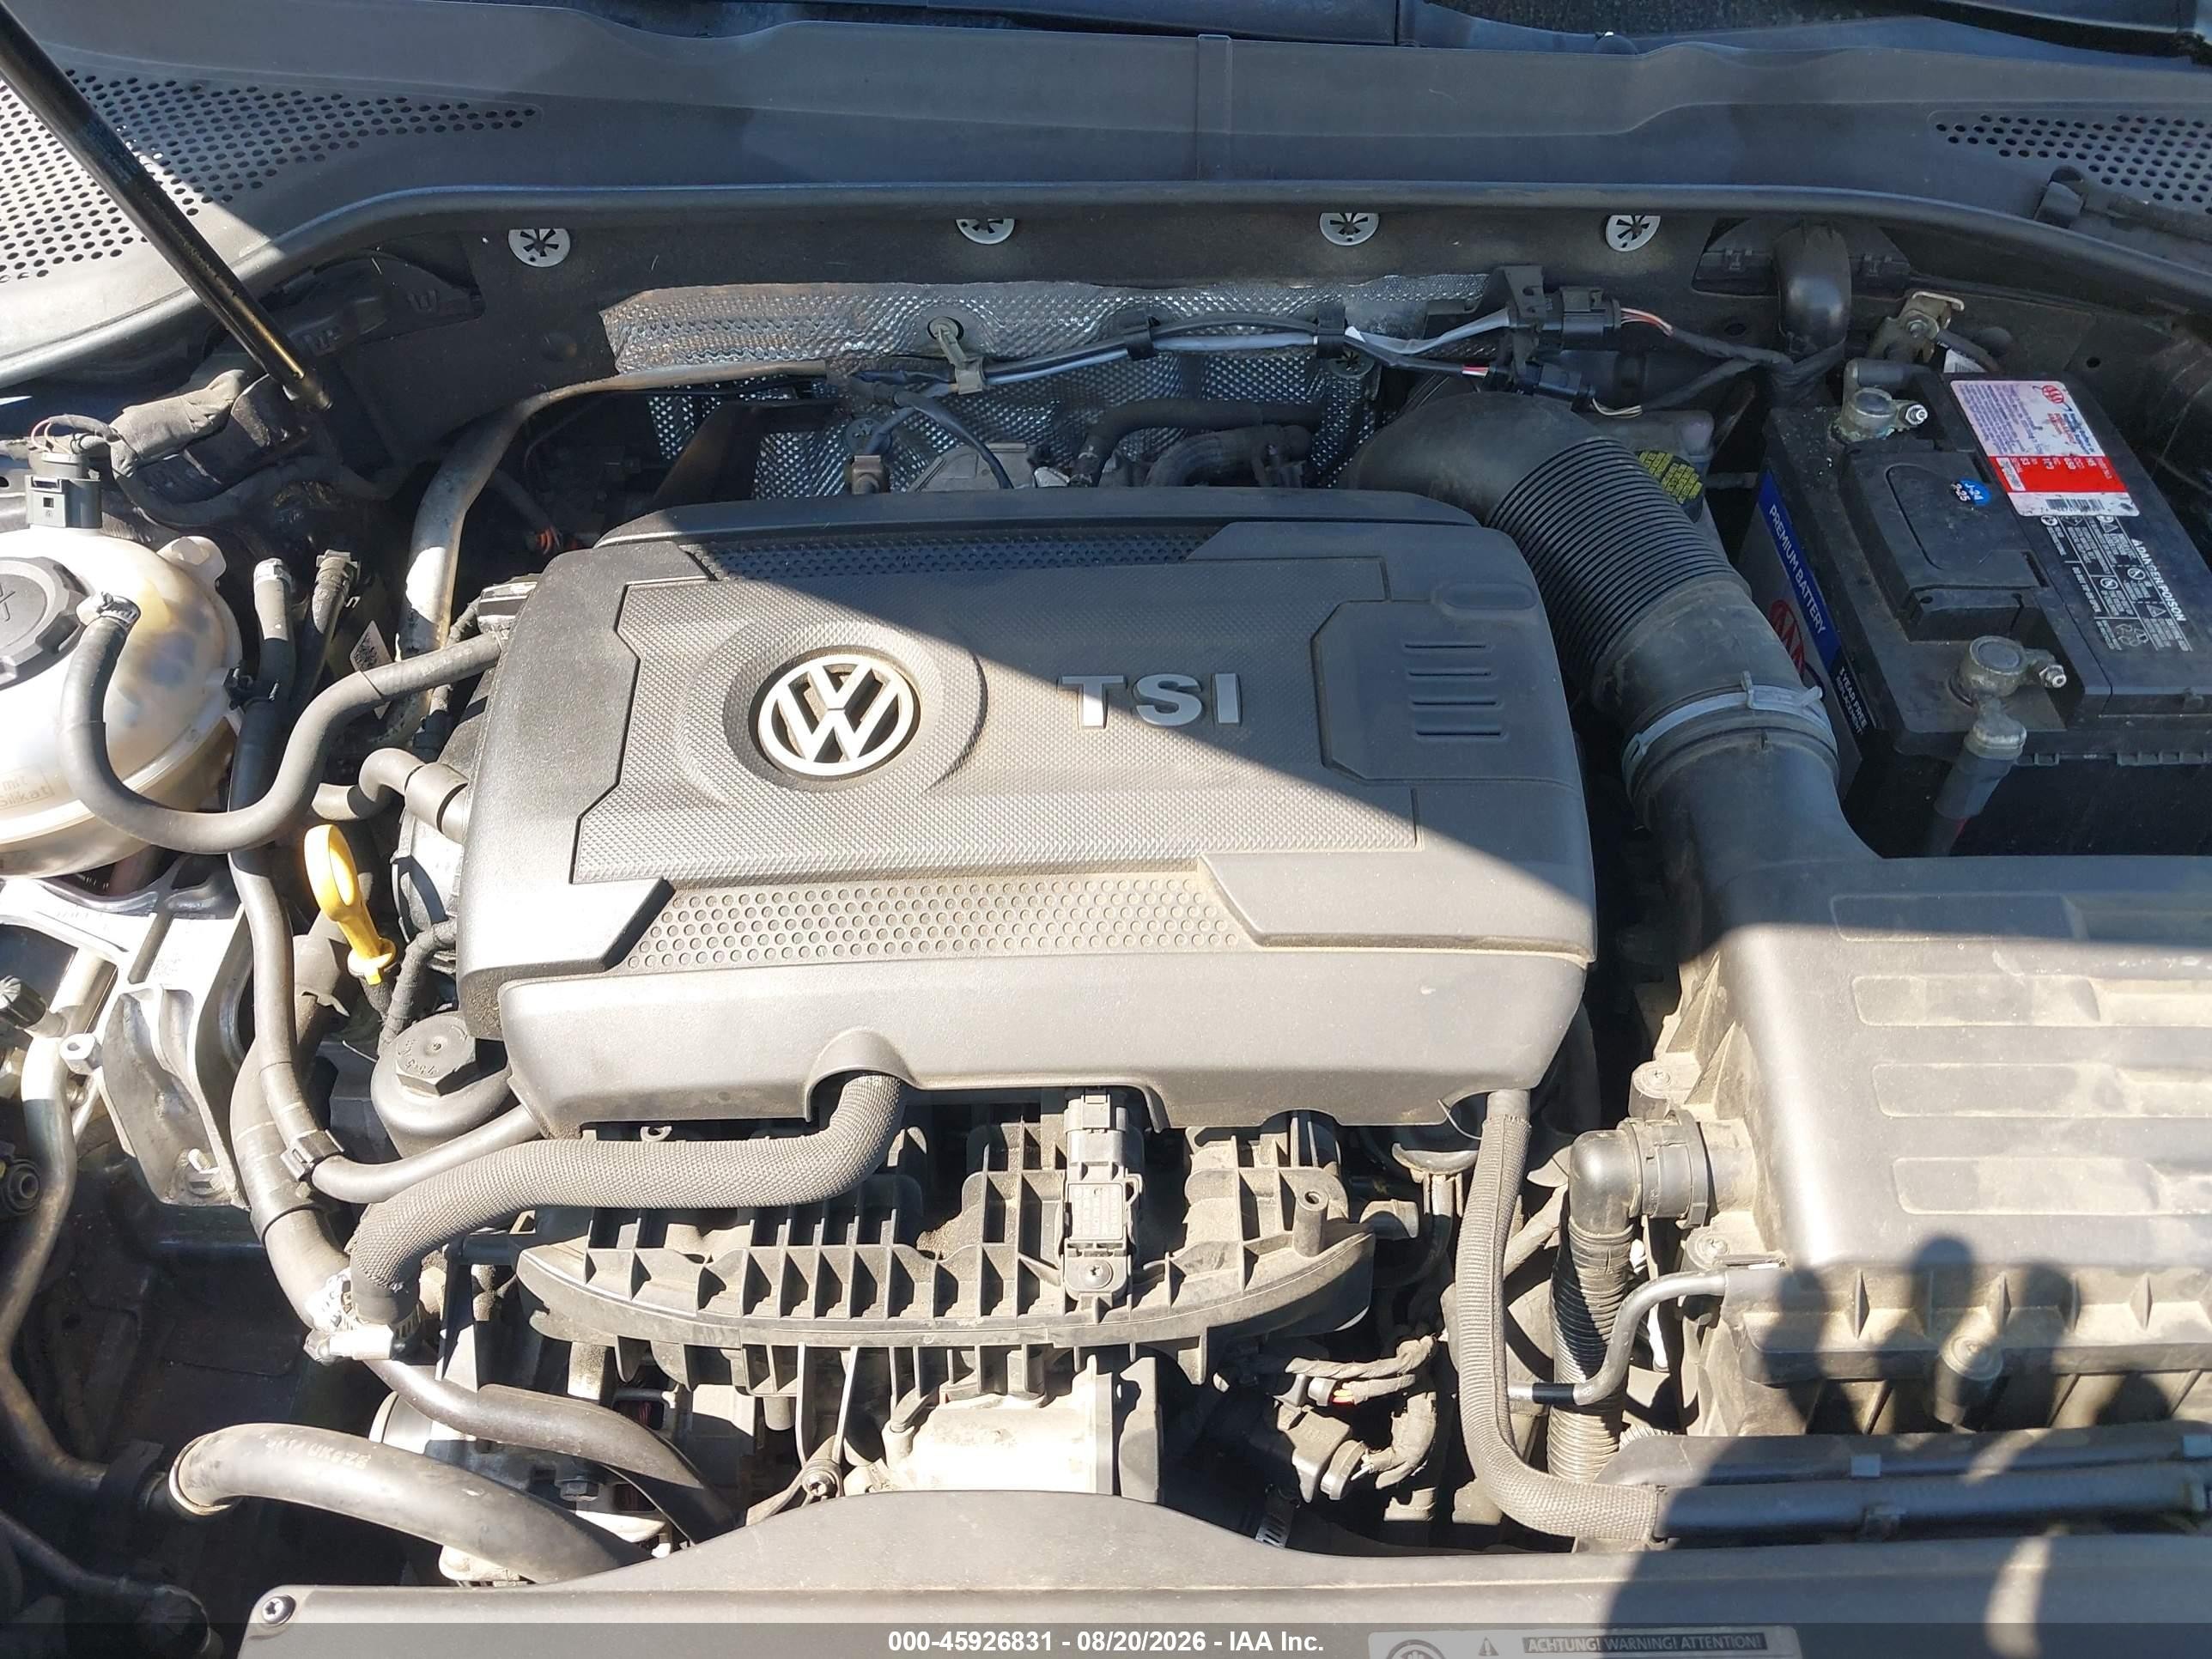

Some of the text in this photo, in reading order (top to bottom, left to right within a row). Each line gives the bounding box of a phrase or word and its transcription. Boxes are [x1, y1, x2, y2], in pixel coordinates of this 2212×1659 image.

[1769, 503, 1826, 635] PREMIUM BATTERY
[1060, 672, 1242, 729] TSI
[1841, 676, 1858, 705] YEAR
[1851, 700, 1869, 729] FREE
[1528, 1633, 1761, 1652] ACHTUNG! WARNING! ATTENTION!
